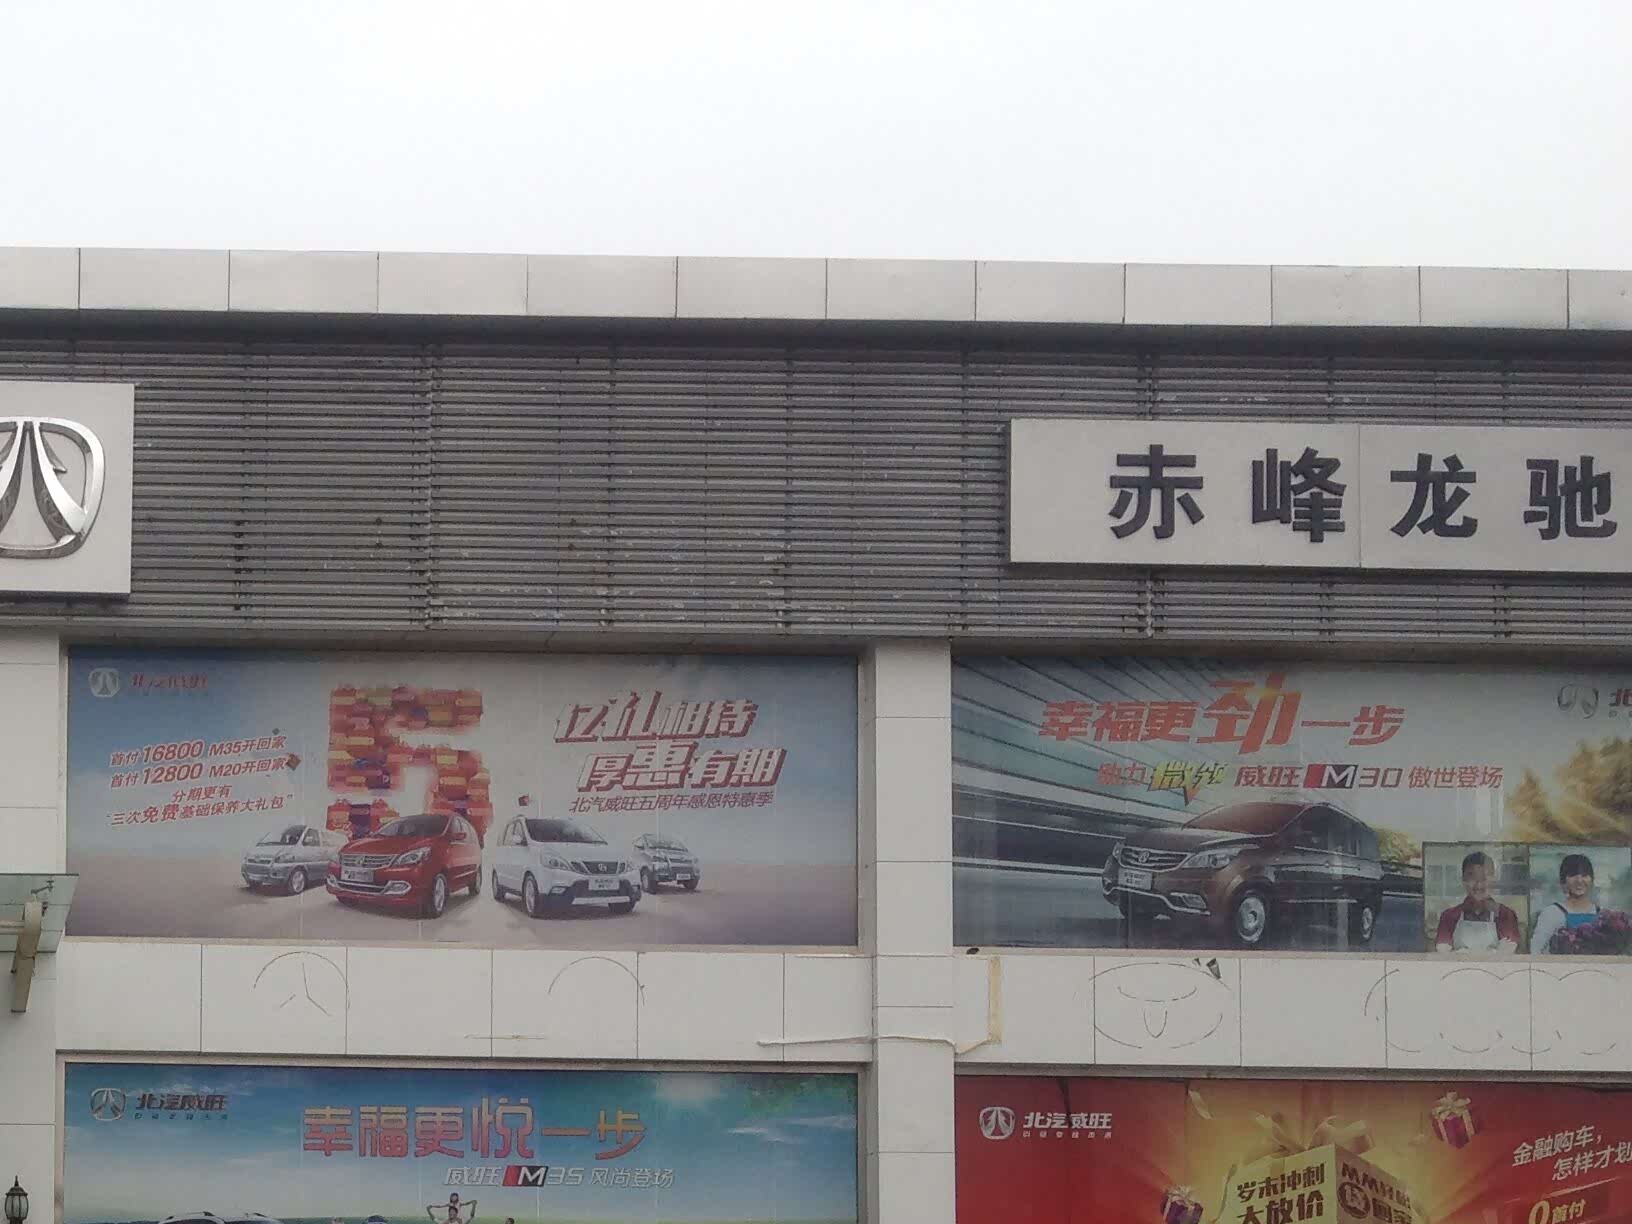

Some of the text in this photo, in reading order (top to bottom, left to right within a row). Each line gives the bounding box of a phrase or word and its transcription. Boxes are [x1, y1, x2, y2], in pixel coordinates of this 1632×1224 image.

[1109, 443, 1617, 542] 赤峰龙驰
[1040, 672, 1406, 754] 幸福更劲一步
[577, 740, 787, 792] 厚惠有期
[1409, 766, 1504, 790] 傲世登场
[303, 1097, 647, 1160] 幸福更悦一步
[1023, 1112, 1112, 1129] 北汽威旺
[591, 1169, 675, 1188] 风尚登场
[1552, 1142, 1632, 1180] 怎样才划
[1236, 1163, 1326, 1203] 岁末冲刺
